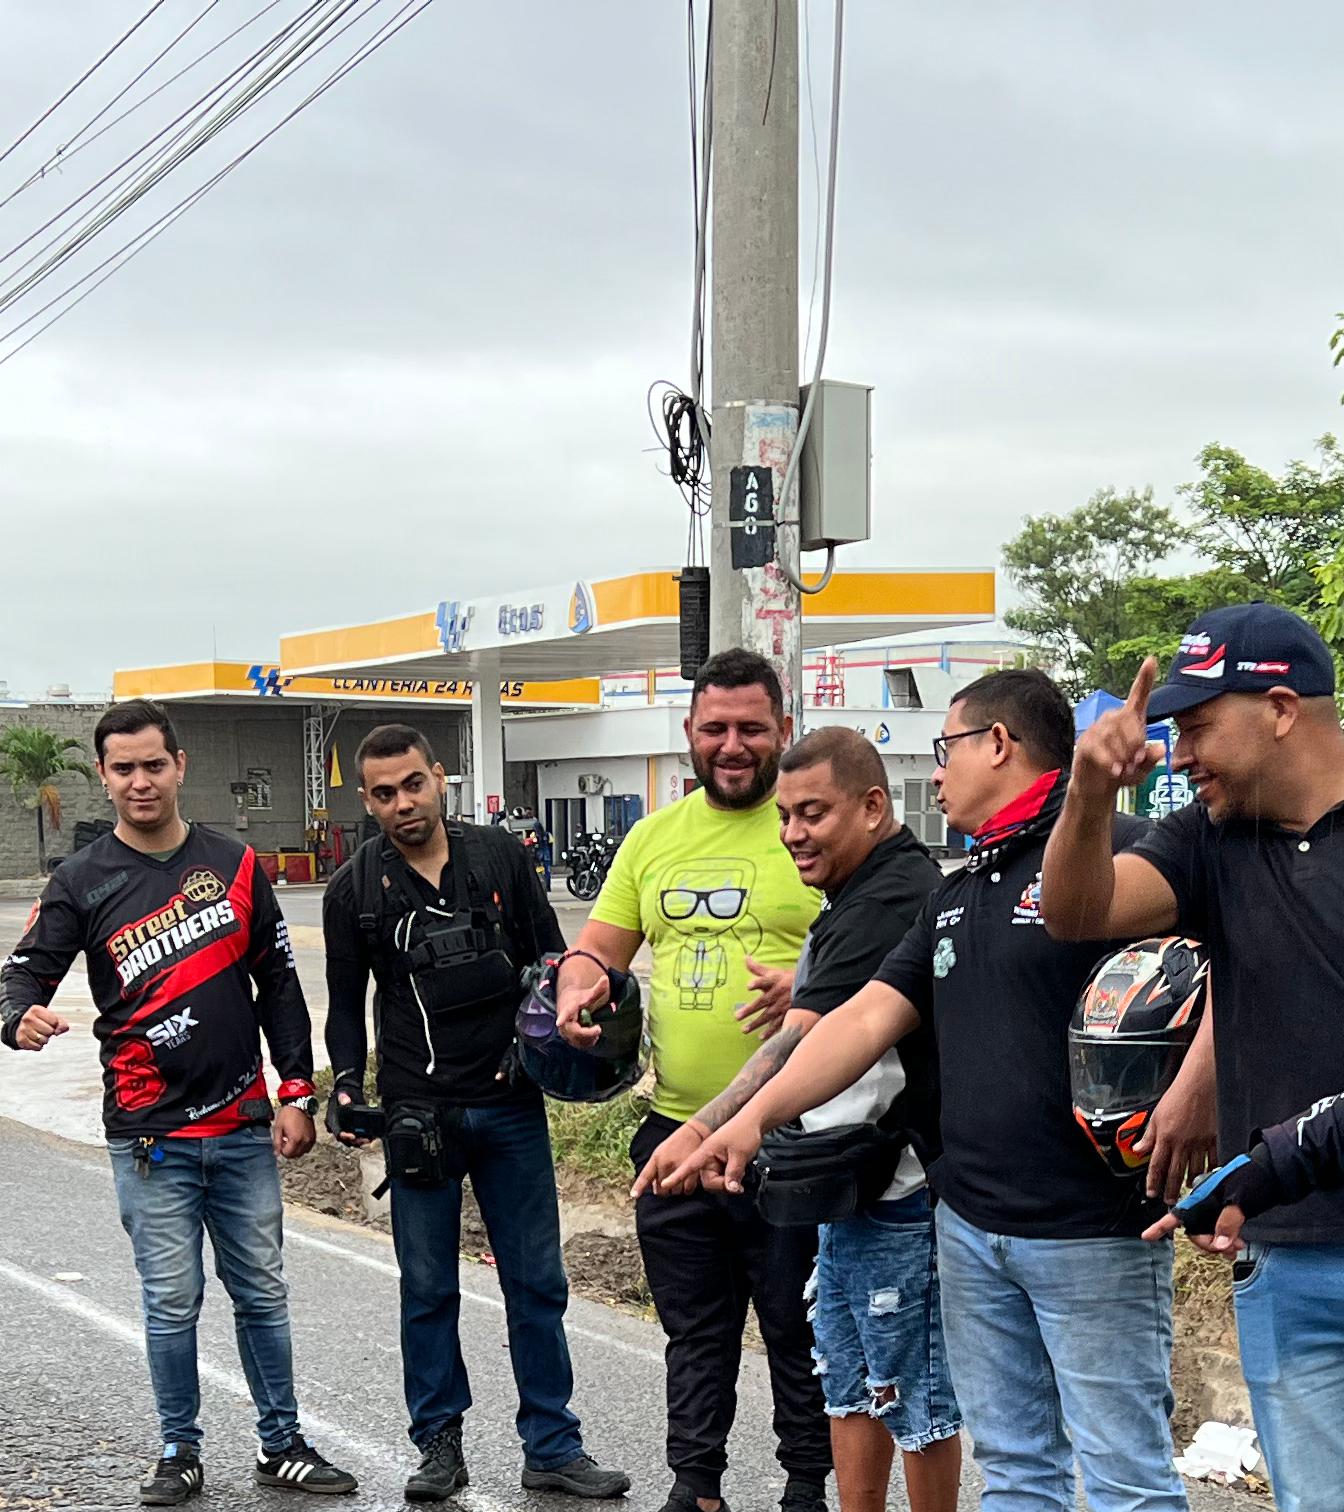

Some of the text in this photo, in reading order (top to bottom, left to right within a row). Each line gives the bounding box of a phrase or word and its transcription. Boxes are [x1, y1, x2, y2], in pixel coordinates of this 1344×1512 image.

[435, 681, 458, 695] 24
[462, 682, 524, 697] HAS
[109, 899, 189, 963] Street
[116, 900, 236, 988] BROTHERS
[145, 1006, 199, 1047] SIX
[164, 1030, 192, 1050] YEARS
